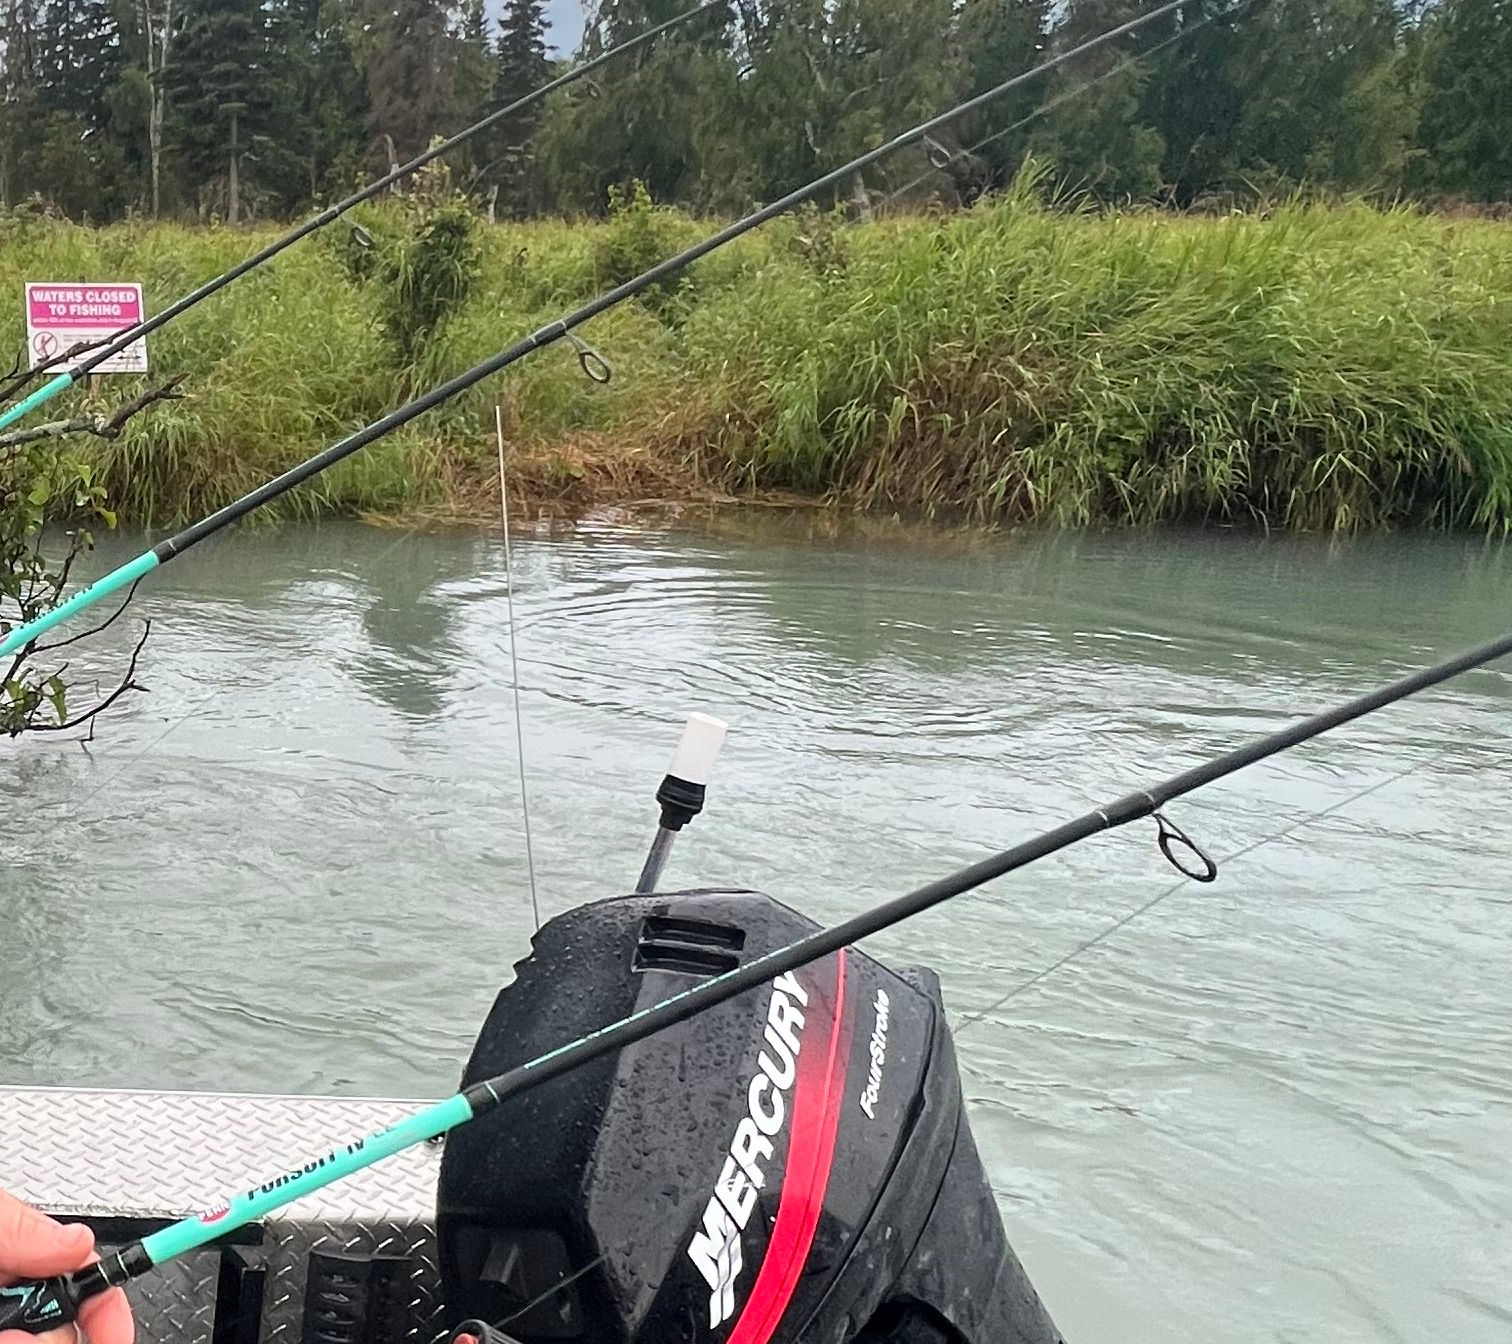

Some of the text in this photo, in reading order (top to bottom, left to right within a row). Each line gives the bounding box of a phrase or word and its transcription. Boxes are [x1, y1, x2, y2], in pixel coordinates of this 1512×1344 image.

[31, 290, 137, 303] WATERS CLOSED
[48, 304, 122, 316] TO FISHING
[859, 988, 890, 1120] FourStroke
[687, 969, 809, 1330] MERCURY
